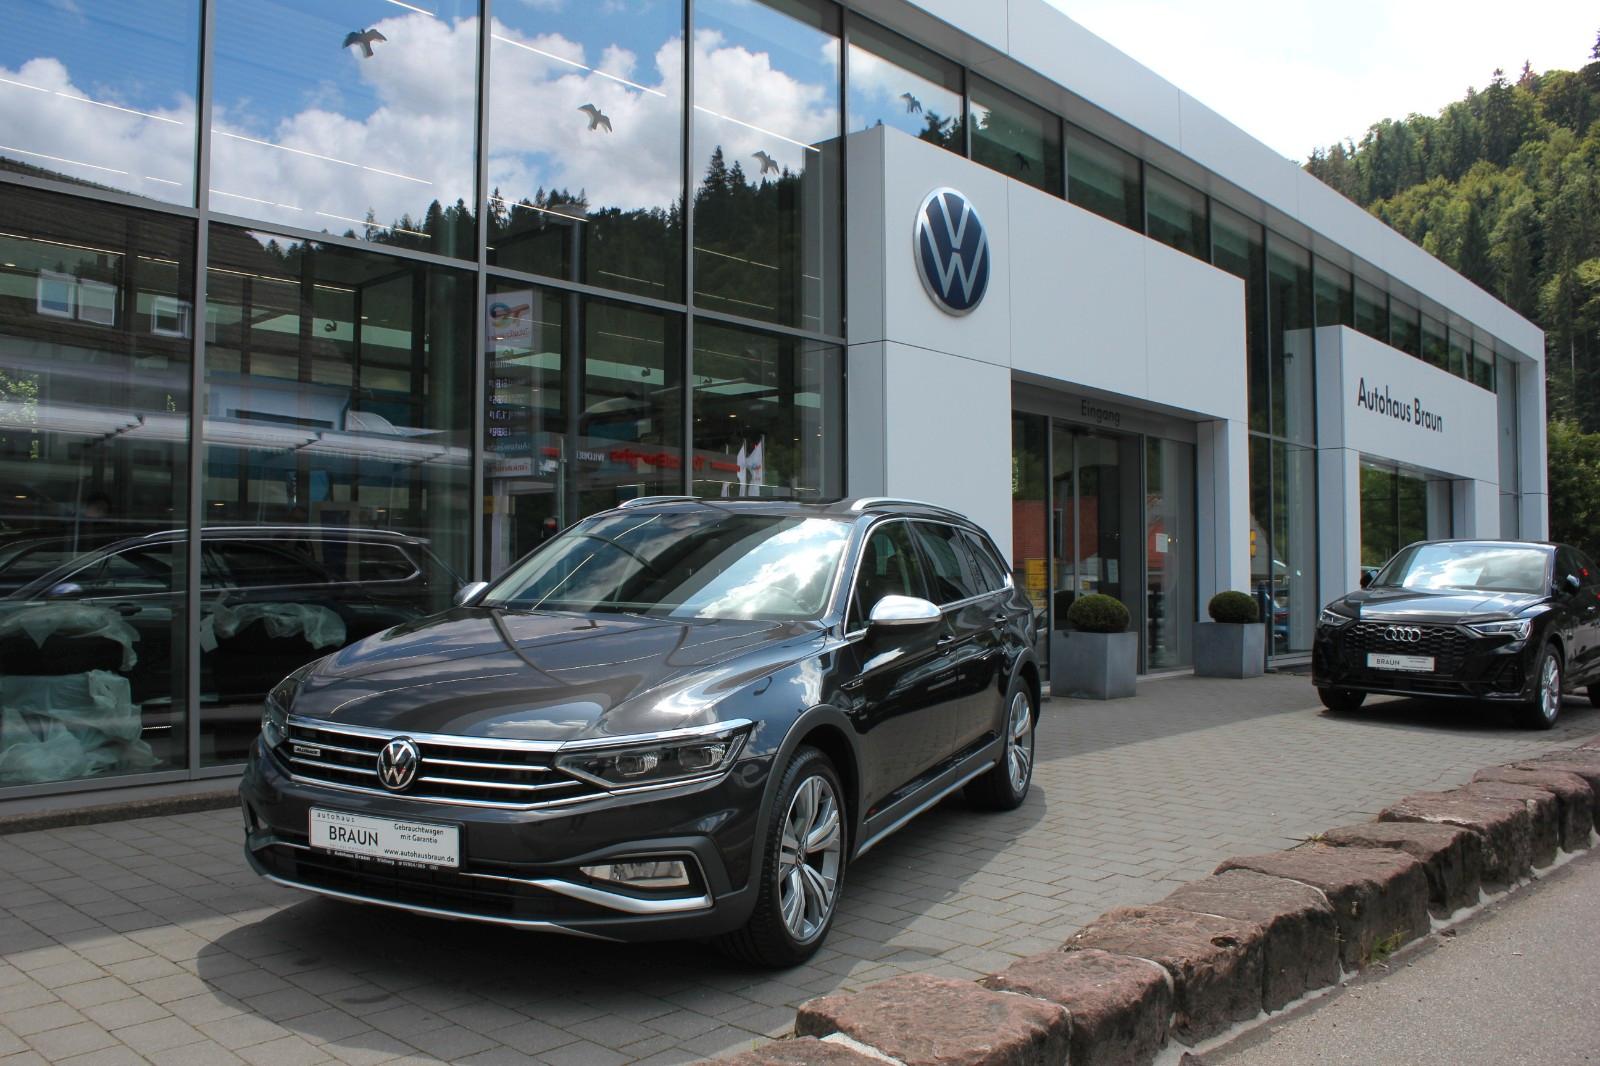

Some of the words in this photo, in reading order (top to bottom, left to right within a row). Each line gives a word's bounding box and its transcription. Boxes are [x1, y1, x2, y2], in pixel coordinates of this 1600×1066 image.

[1357, 377, 1411, 422] Autohaus
[1414, 397, 1443, 432] Braun
[1081, 399, 1121, 427] Eingang
[1376, 658, 1400, 666] BRAUN
[316, 812, 355, 823] autohaus
[329, 825, 378, 846] BRAUN
[393, 823, 444, 836] Gebrauchtwagen
[400, 833, 411, 841] mit
[412, 834, 438, 844] Garantie
[383, 847, 455, 863] www.autohausbraun.de
